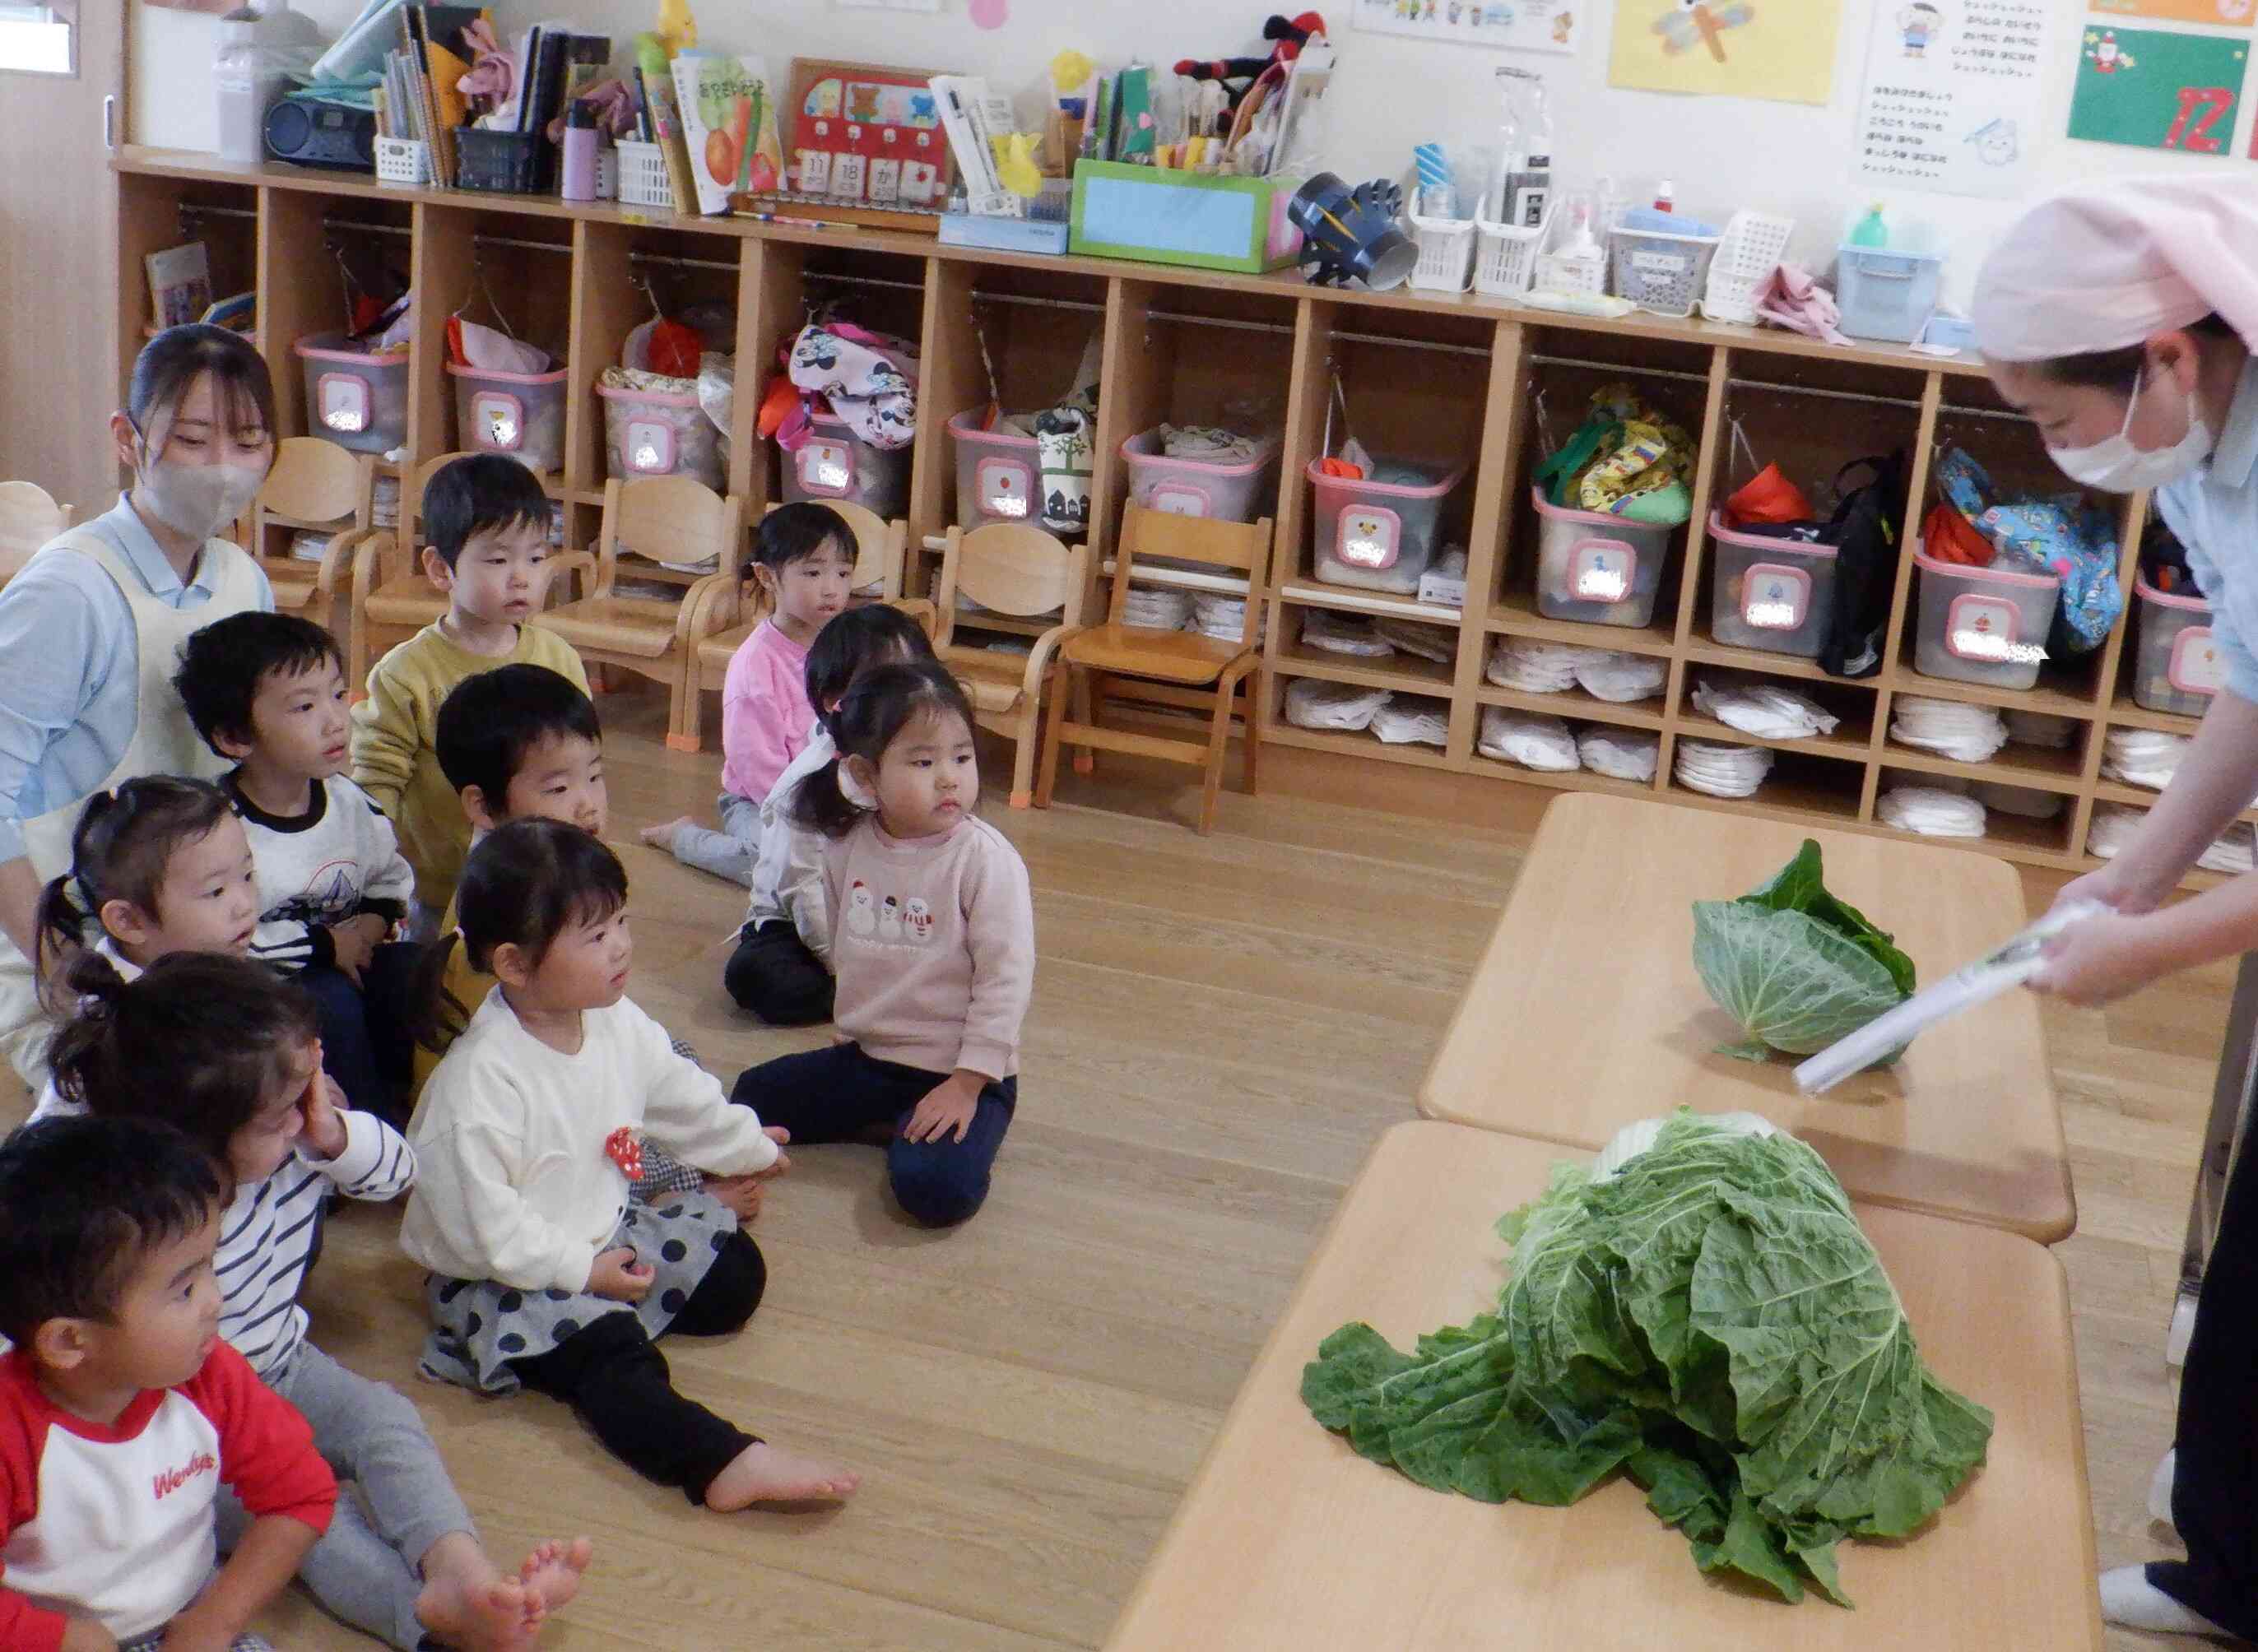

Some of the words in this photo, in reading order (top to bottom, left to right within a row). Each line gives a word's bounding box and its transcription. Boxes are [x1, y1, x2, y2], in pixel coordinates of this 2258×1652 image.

[2162, 86, 2235, 151] 12
[811, 158, 823, 173] 11
[843, 165, 857, 179] 18
